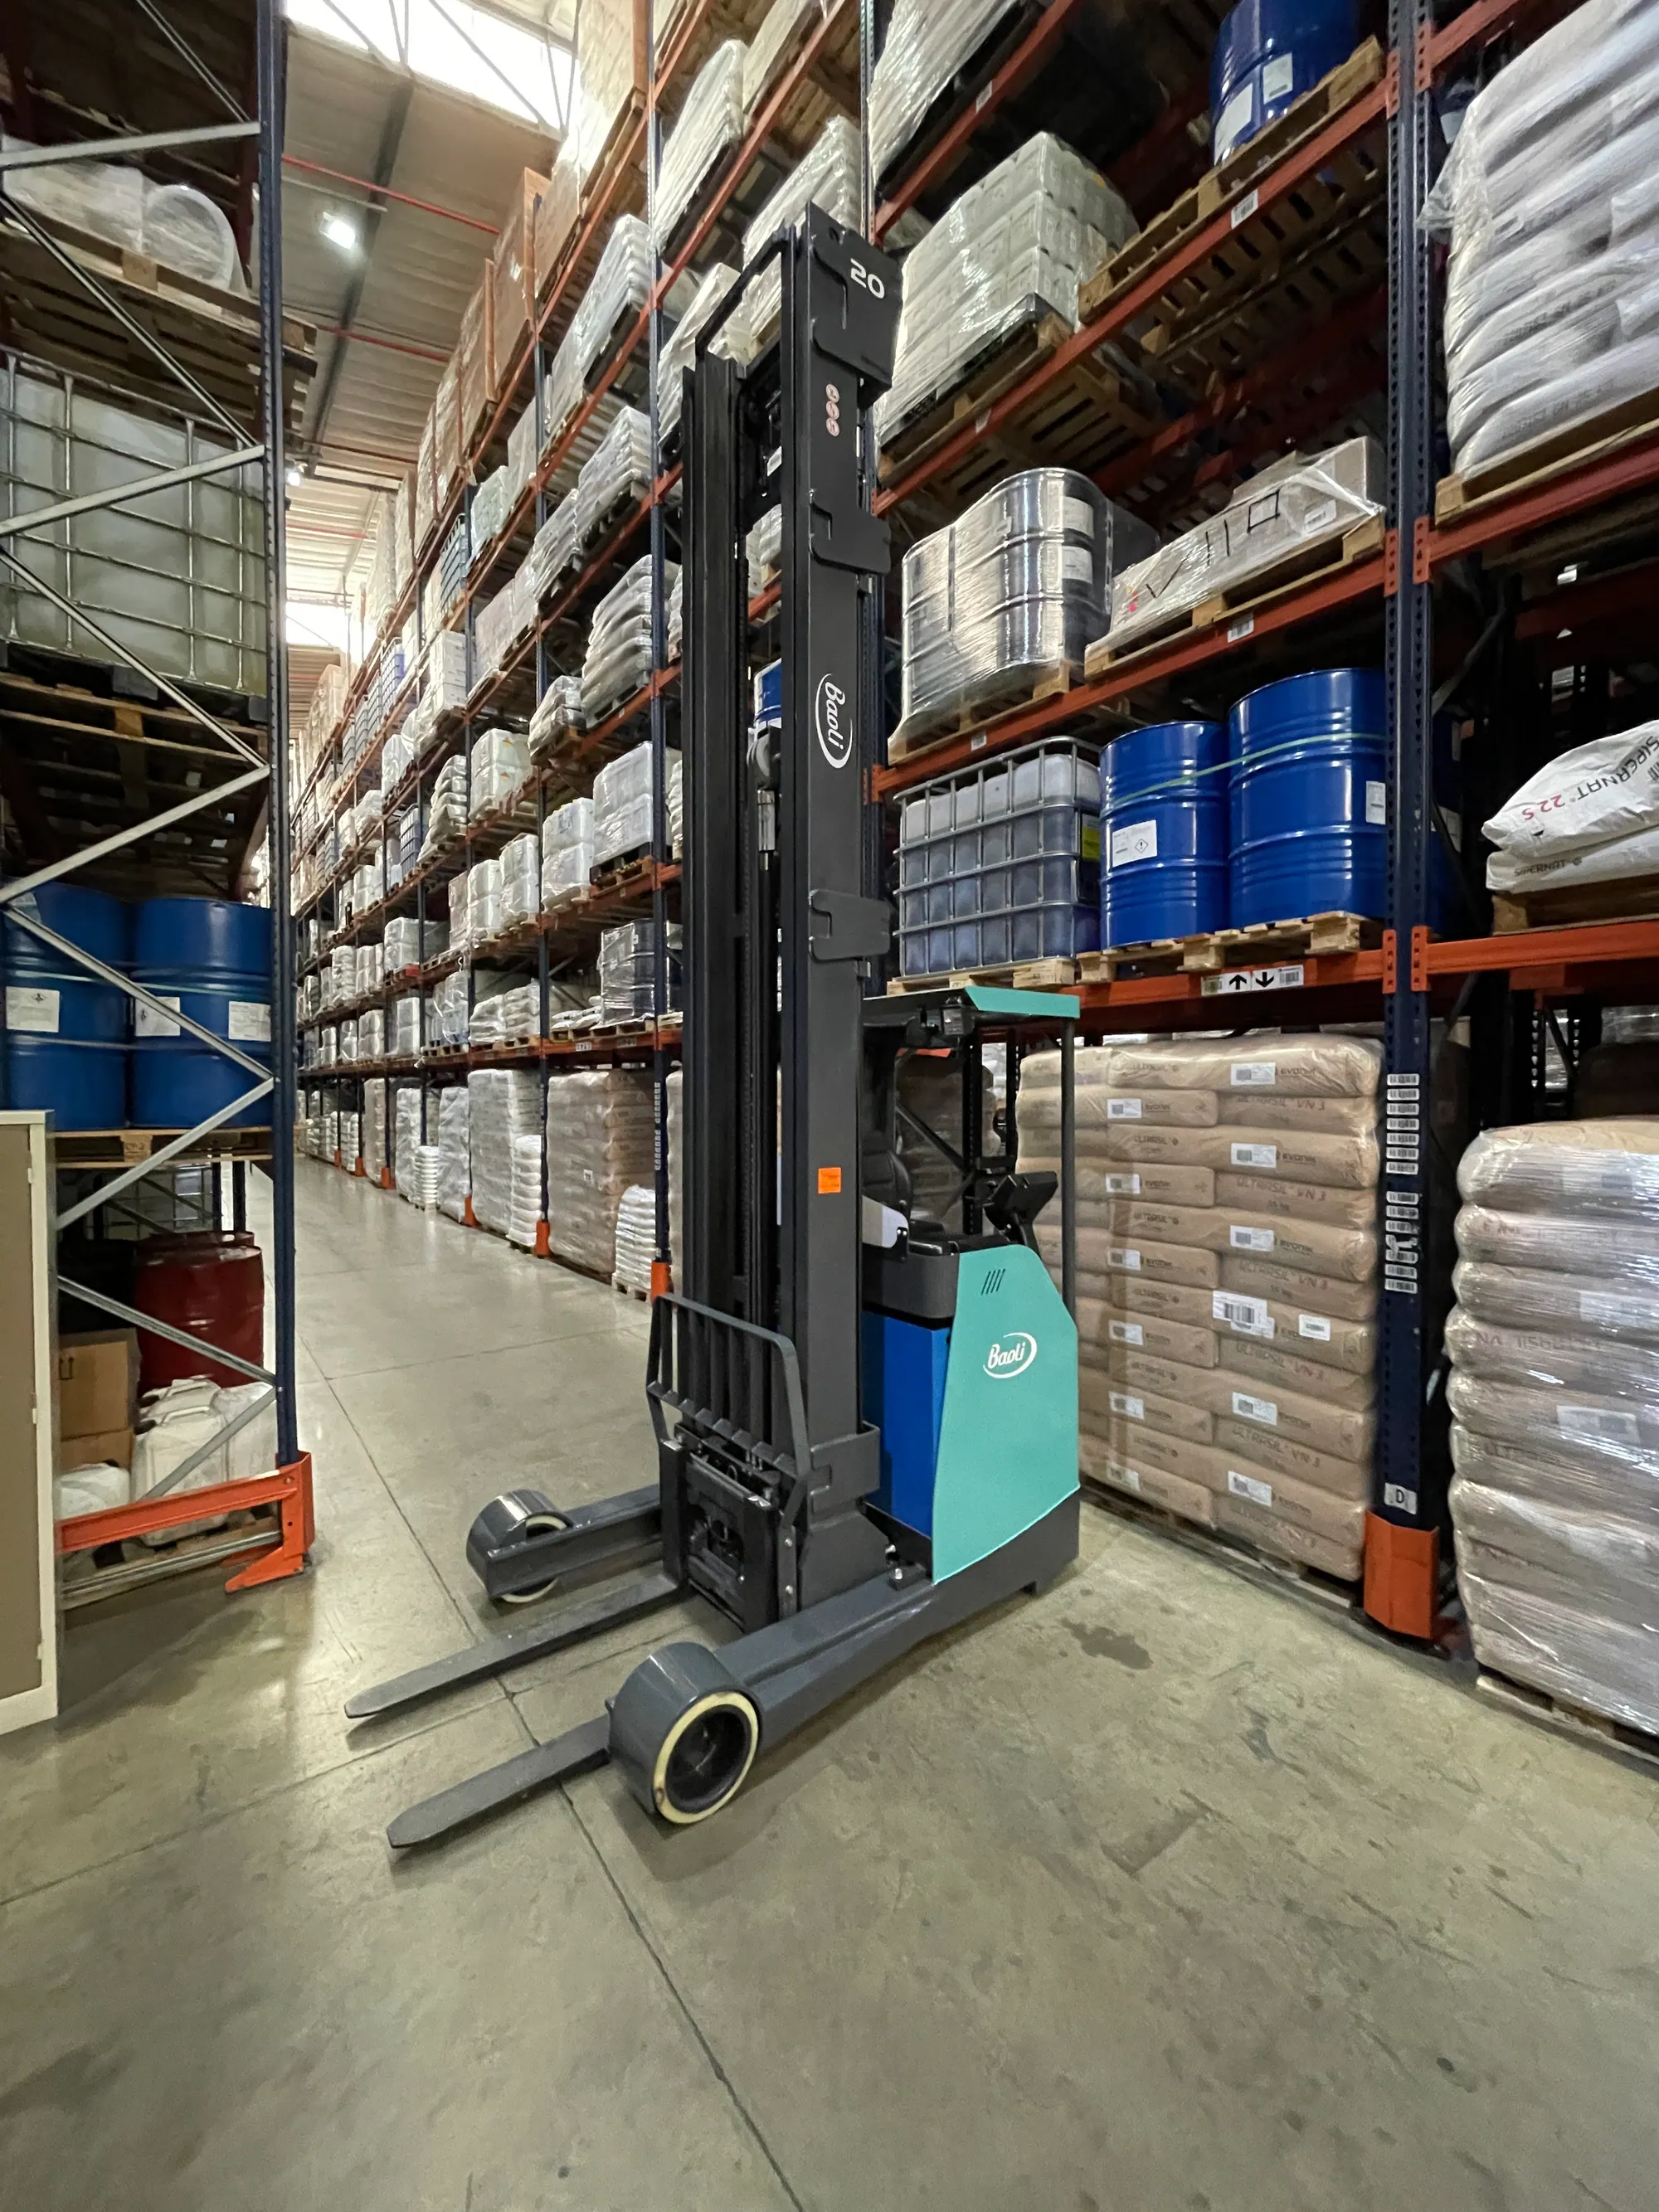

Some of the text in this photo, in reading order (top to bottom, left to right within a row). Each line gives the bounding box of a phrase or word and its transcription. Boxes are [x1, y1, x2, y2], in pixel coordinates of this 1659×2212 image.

[850, 258, 885, 299] 20
[1521, 735, 1659, 820] SIPERNAT 22 S
[1514, 858, 1568, 877] SIPERNAT
[987, 1341, 1026, 1369] Baoli
[1395, 1488, 1406, 1504] D
